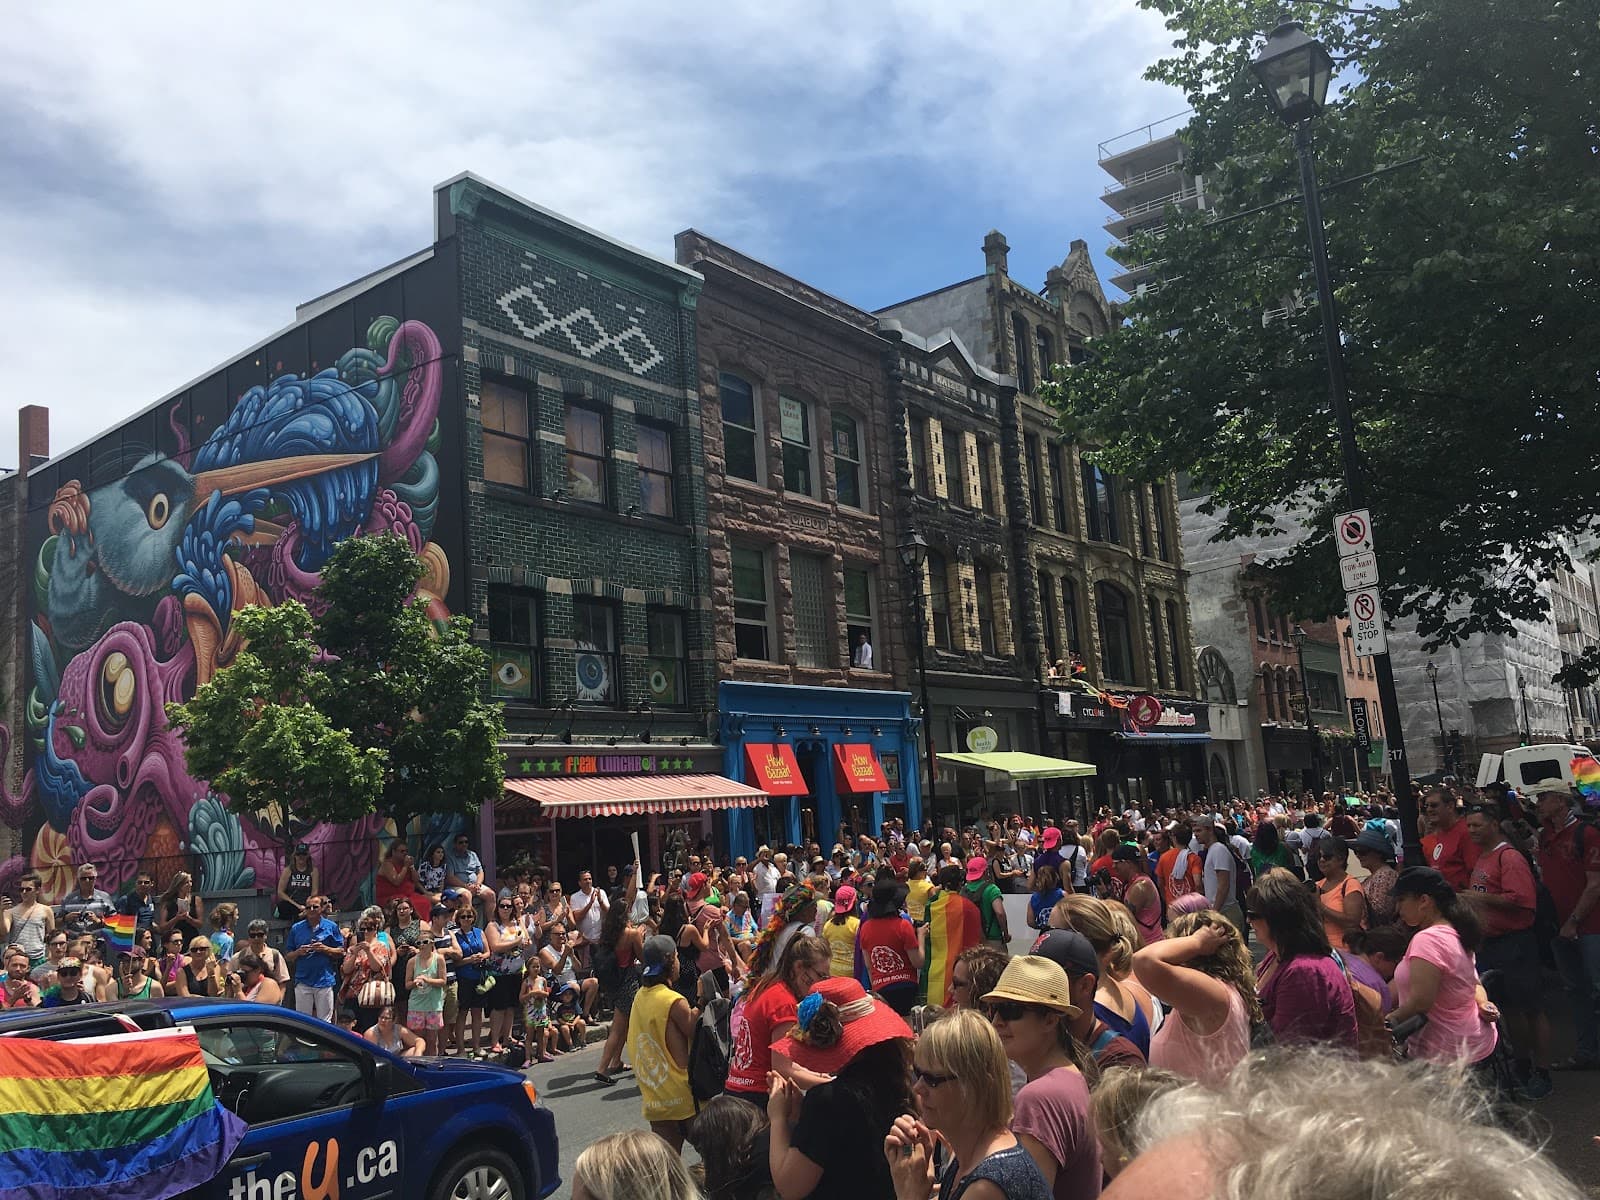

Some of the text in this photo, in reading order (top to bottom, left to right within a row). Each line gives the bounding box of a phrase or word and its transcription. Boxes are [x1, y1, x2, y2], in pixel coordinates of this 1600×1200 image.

[1344, 560, 1372, 571] TOW-AWAY
[1353, 572, 1368, 581] ZONE
[1358, 620, 1375, 631] BUS
[1357, 630, 1379, 641] STOP
[1354, 706, 1367, 746] FLOWER
[766, 754, 784, 768] How
[852, 754, 868, 765] How
[765, 764, 792, 779] Bazaar!
[852, 763, 876, 777] Bazaar!
